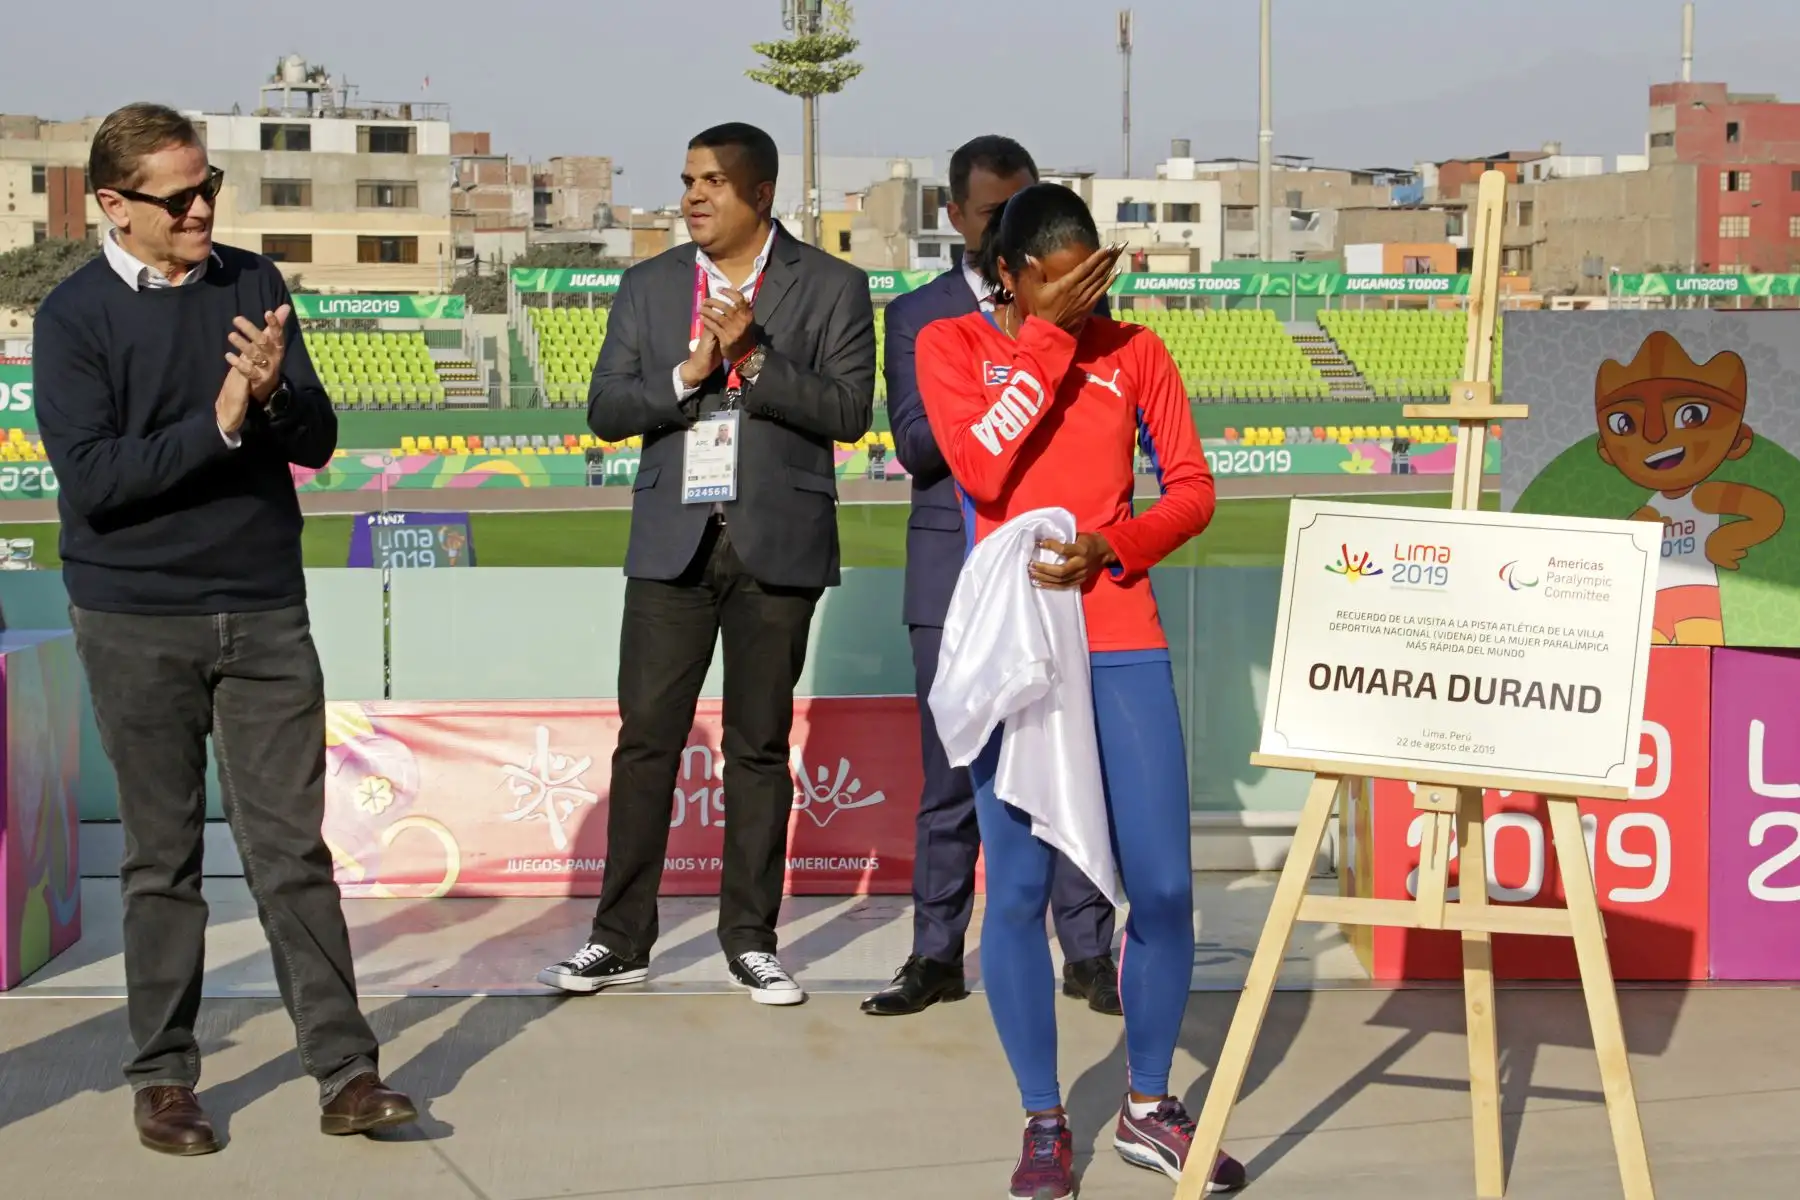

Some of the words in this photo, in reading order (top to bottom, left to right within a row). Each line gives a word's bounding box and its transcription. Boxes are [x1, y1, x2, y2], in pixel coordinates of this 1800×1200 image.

[1134, 278, 1196, 289] JUGAMOS
[1198, 278, 1241, 290] TODOS
[1346, 278, 1405, 290] JUGAMOS
[1407, 278, 1449, 290] TODOS
[970, 370, 1044, 456] CUBA
[1547, 556, 1604, 571] Americas
[1391, 563, 1448, 585] 2019
[1546, 571, 1613, 587] Paralympic
[1544, 586, 1610, 602] Committee
[1336, 610, 1387, 622] RECUERDO
[1388, 614, 1401, 623] DE
[1403, 615, 1415, 625] LA
[1417, 616, 1447, 626] VISITA
[1448, 619, 1455, 628] A
[1456, 619, 1469, 629] LA
[1471, 620, 1498, 630] PISTA
[1500, 622, 1545, 634] ATLÉTICA
[1547, 626, 1561, 636] DE
[1563, 627, 1575, 637] LA
[1577, 628, 1605, 639] VILLA
[1328, 622, 1382, 634] DEPORTIVA
[1383, 627, 1431, 638] NACIONAL
[1433, 630, 1477, 643] (VIDENA)
[1479, 633, 1492, 643] DE
[1494, 635, 1506, 645] LA
[1508, 636, 1541, 647] MUJER
[1543, 638, 1609, 652] PARALÍMPICA
[1405, 640, 1427, 651] MÁS
[1429, 641, 1465, 654] RÁPIDA
[1466, 645, 1485, 655] DEL
[1487, 647, 1525, 658] MUNDO
[1308, 662, 1438, 700] OMARA
[1447, 674, 1602, 714] DURAND
[1449, 730, 1472, 741] Perú
[1396, 736, 1409, 747] 22
[1410, 738, 1422, 748] de
[1423, 741, 1457, 751] agosto
[1458, 743, 1471, 752] de
[1472, 744, 1496, 755] 2019
[507, 858, 562, 872] JUEGOS
[698, 858, 708, 871] Y
